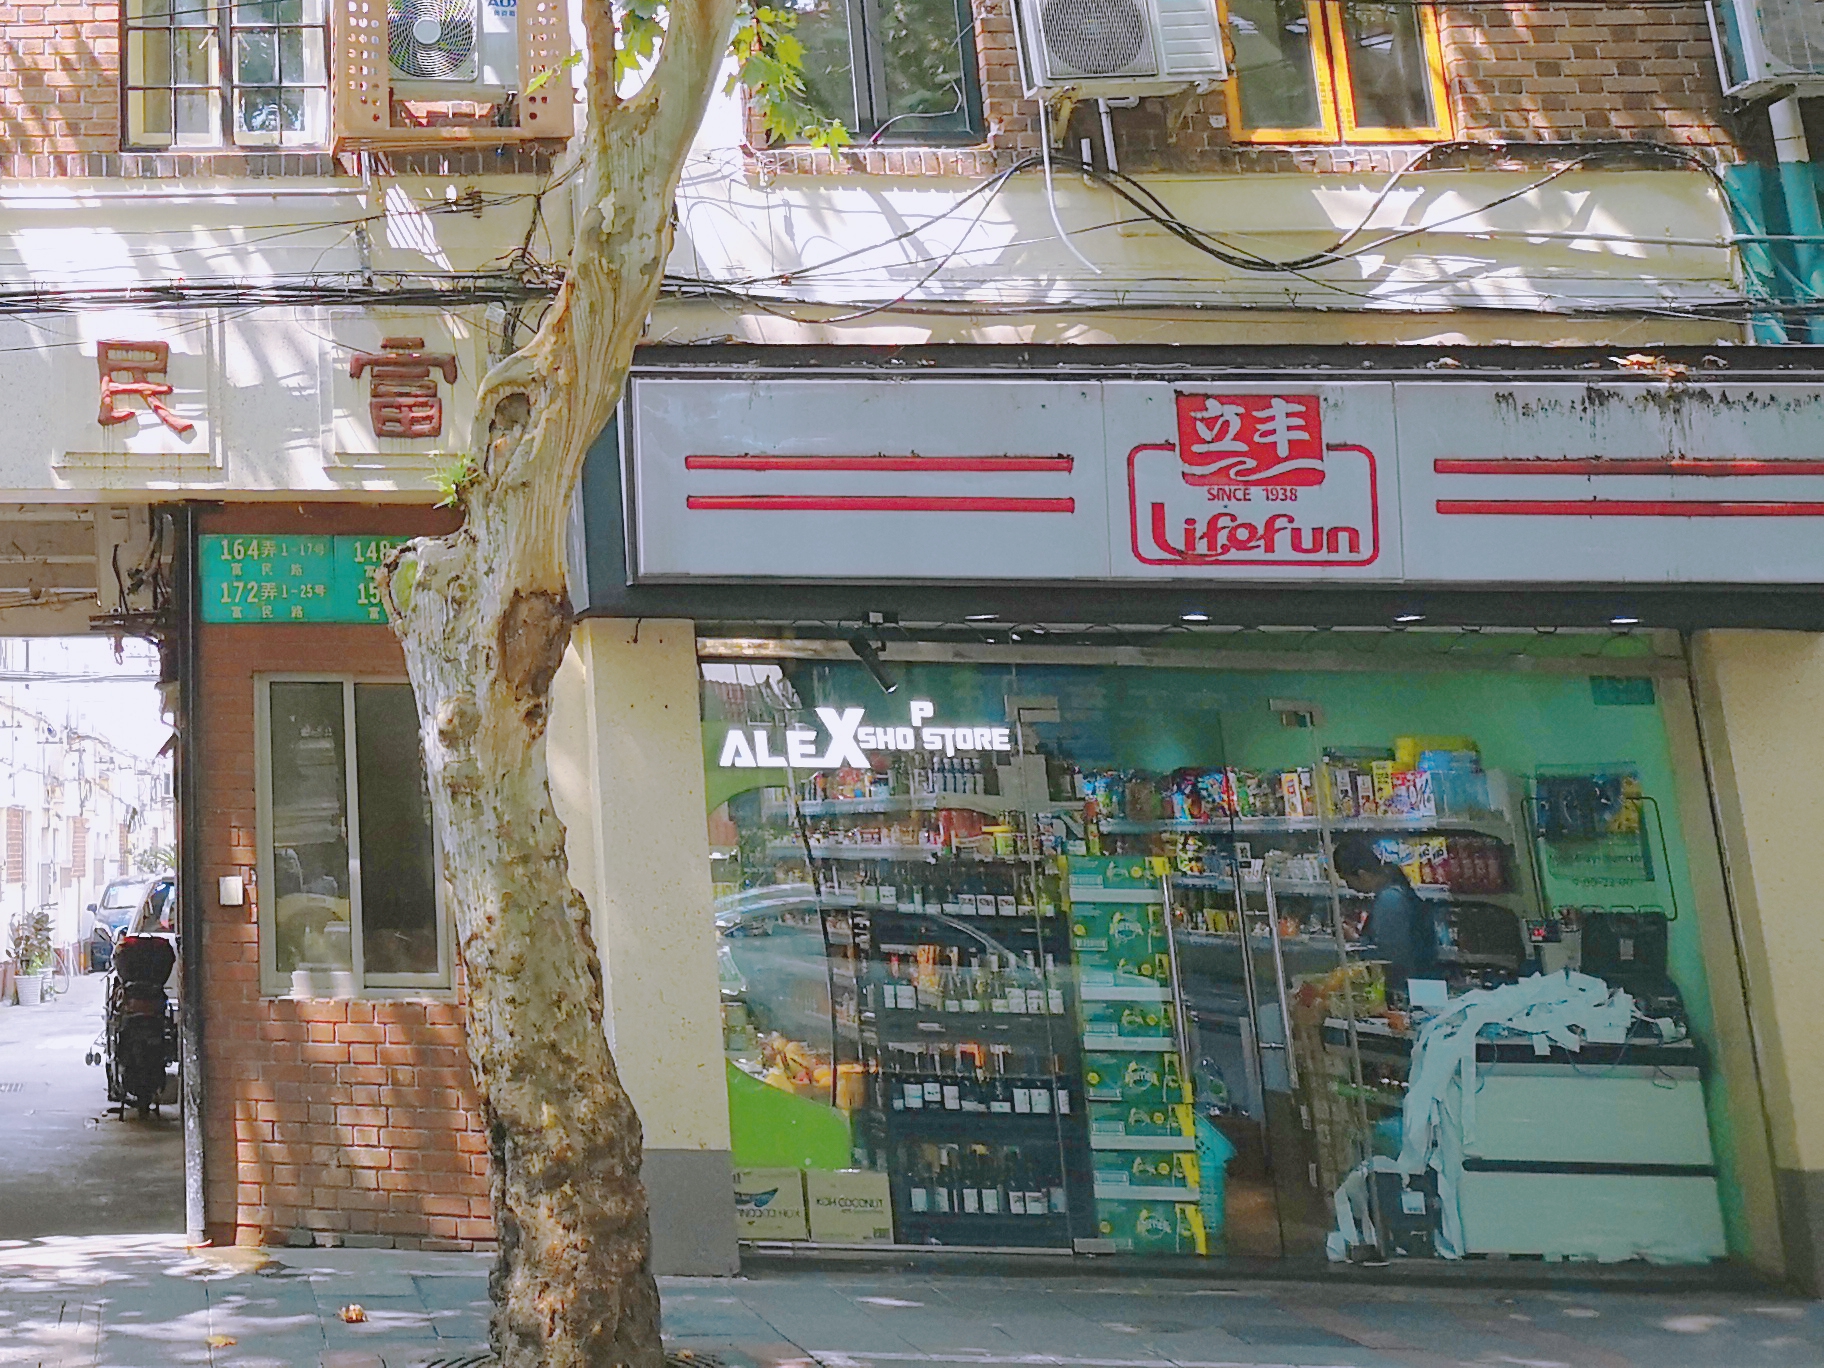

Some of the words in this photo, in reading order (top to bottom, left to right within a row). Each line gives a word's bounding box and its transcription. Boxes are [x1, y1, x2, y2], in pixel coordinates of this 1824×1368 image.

[1189, 397, 1311, 459] 立丰
[1206, 487, 1252, 502] SINCE
[1262, 487, 1298, 502] 1938
[1151, 502, 1360, 562] Lifefun
[230, 562, 303, 577] 富民路
[231, 605, 304, 619] 富民路
[719, 707, 871, 768] ALEX
[923, 727, 1012, 758] STORE
